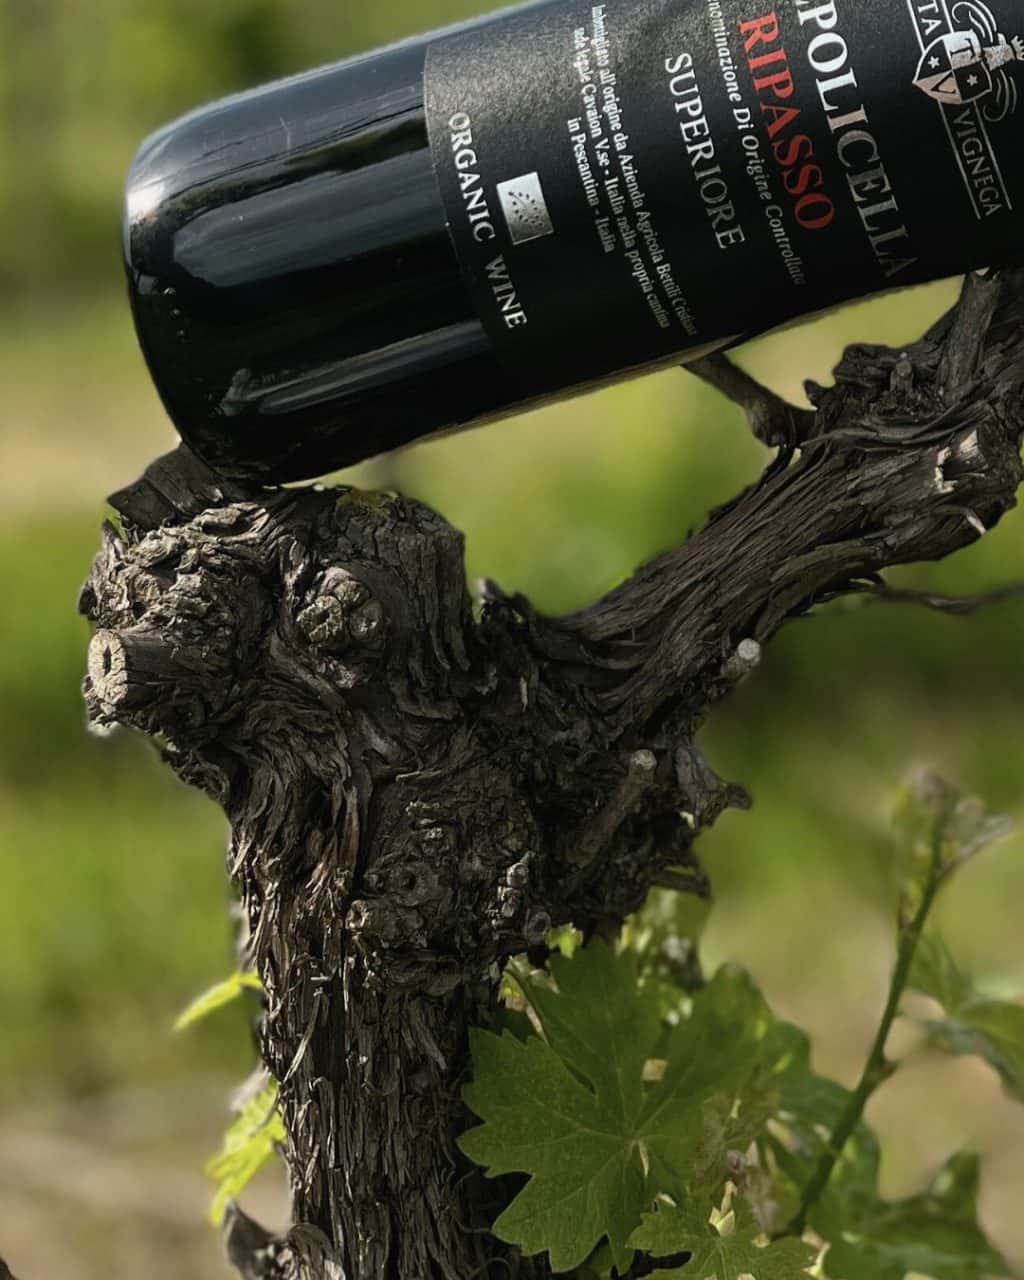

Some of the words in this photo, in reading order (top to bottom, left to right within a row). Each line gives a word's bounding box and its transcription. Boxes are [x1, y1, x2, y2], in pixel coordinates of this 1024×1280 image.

[567, 117, 581, 132] in
[581, 83, 603, 138] Cavaion
[600, 69, 623, 131] all'origine
[733, 107, 754, 130] Di
[738, 11, 835, 229] RIPASSO
[613, 132, 628, 151] da
[665, 53, 745, 249] SUPERIORE
[742, 135, 772, 200] Origine
[951, 108, 1002, 217] VIGNEGA
[570, 132, 600, 207] Pescantina
[604, 176, 626, 215] Italia
[619, 155, 645, 209] Azienda
[449, 112, 496, 242] ORGANIC
[485, 255, 528, 329] WINE
[595, 217, 617, 253] Italia
[617, 216, 637, 248] nella
[636, 211, 664, 263] Agricola
[624, 249, 655, 293] propria
